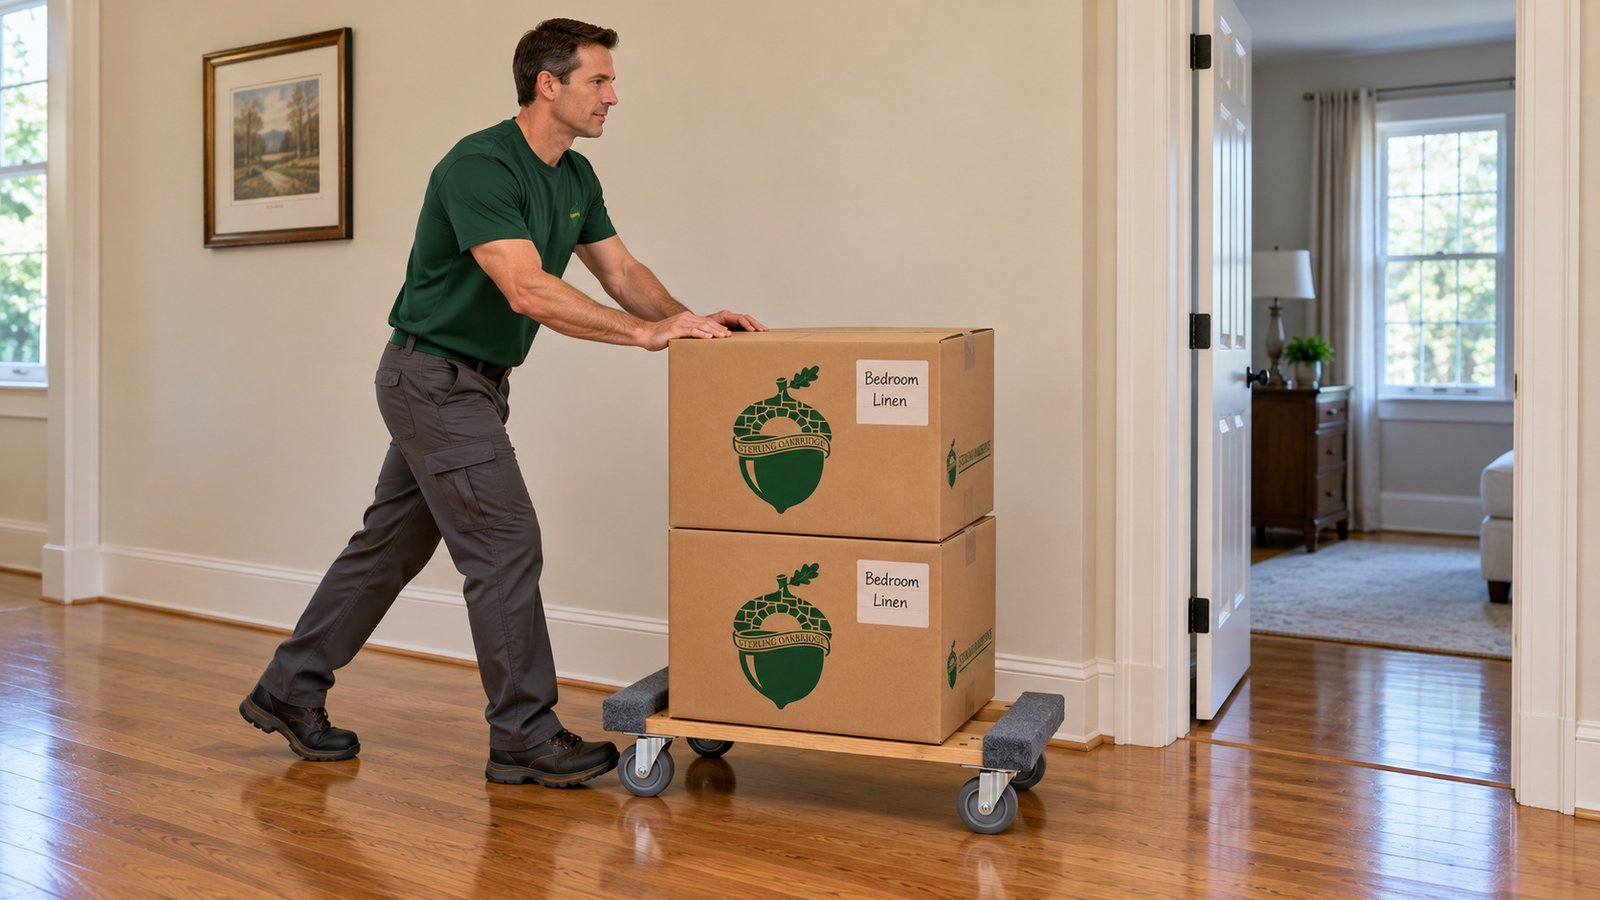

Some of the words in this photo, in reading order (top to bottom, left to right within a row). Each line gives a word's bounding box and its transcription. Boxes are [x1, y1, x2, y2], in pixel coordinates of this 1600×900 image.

[865, 371, 919, 385] Bedroom
[873, 393, 907, 407] Linen
[738, 442, 777, 453] STERLING
[778, 437, 826, 448] OAKBRIDGE
[865, 571, 919, 588] Bedroom
[873, 593, 908, 609] Linen
[738, 638, 777, 648] STERLING
[778, 634, 825, 645] OAKBRIDGE
